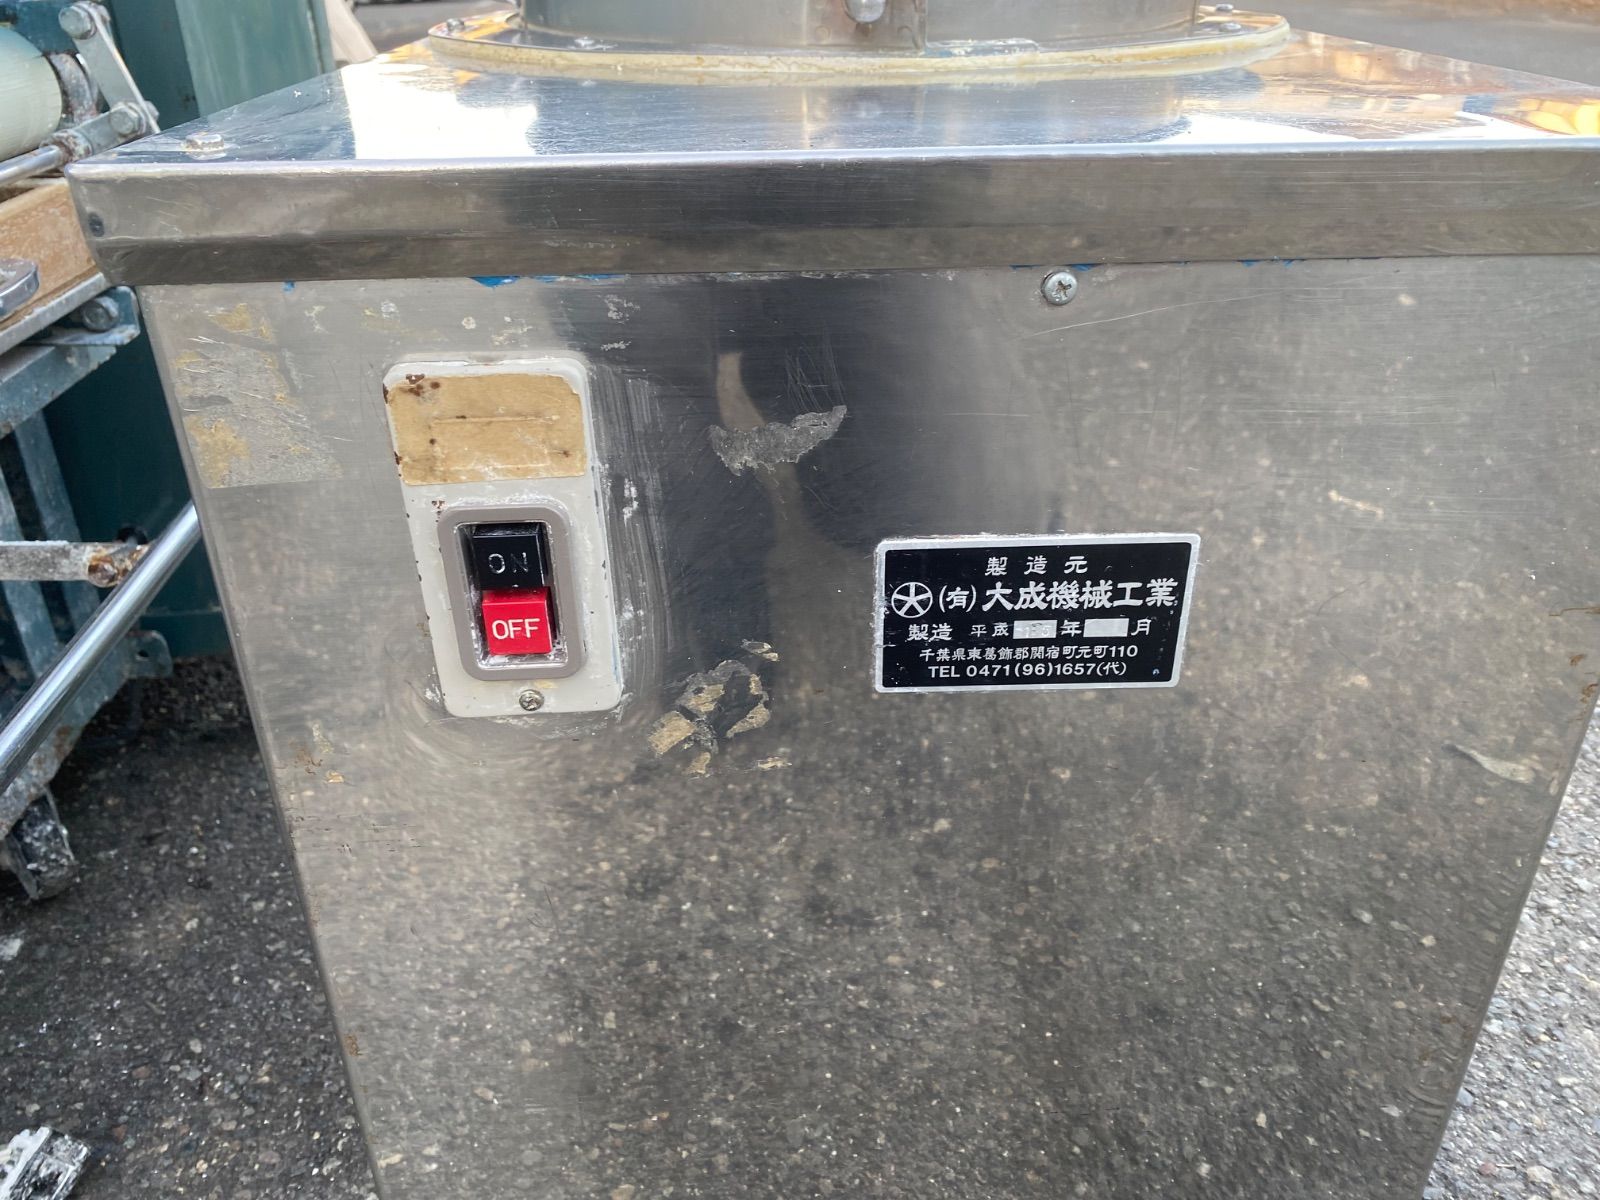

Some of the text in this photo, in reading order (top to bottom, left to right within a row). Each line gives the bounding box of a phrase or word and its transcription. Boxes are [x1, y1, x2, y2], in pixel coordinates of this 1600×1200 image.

[488, 552, 529, 574] ON
[984, 555, 1088, 576] 製造元
[491, 618, 540, 640] OFF
[907, 623, 953, 643] 製造
[970, 622, 1009, 638] 平成
[1061, 619, 1082, 638] 年
[1130, 619, 1152, 636] 月
[928, 661, 1128, 679] TEL 0471(96)1657(代)
